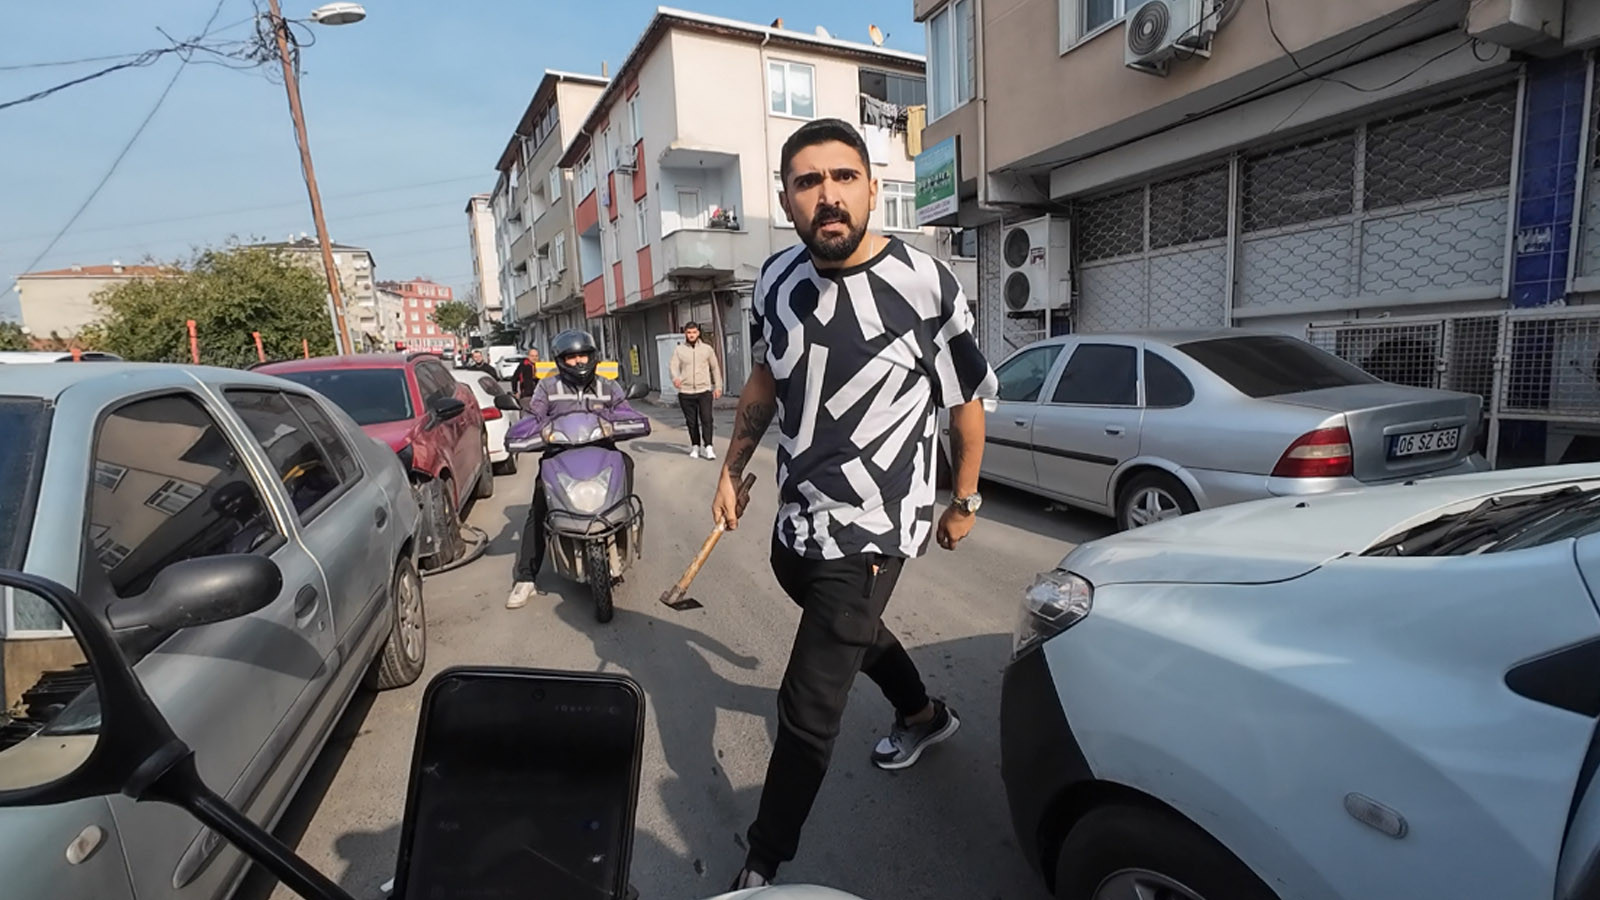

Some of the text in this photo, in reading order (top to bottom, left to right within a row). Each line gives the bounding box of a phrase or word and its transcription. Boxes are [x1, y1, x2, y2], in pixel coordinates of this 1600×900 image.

[1399, 436, 1414, 453] 06
[1418, 434, 1434, 450] SZ
[1437, 430, 1456, 448] 636
